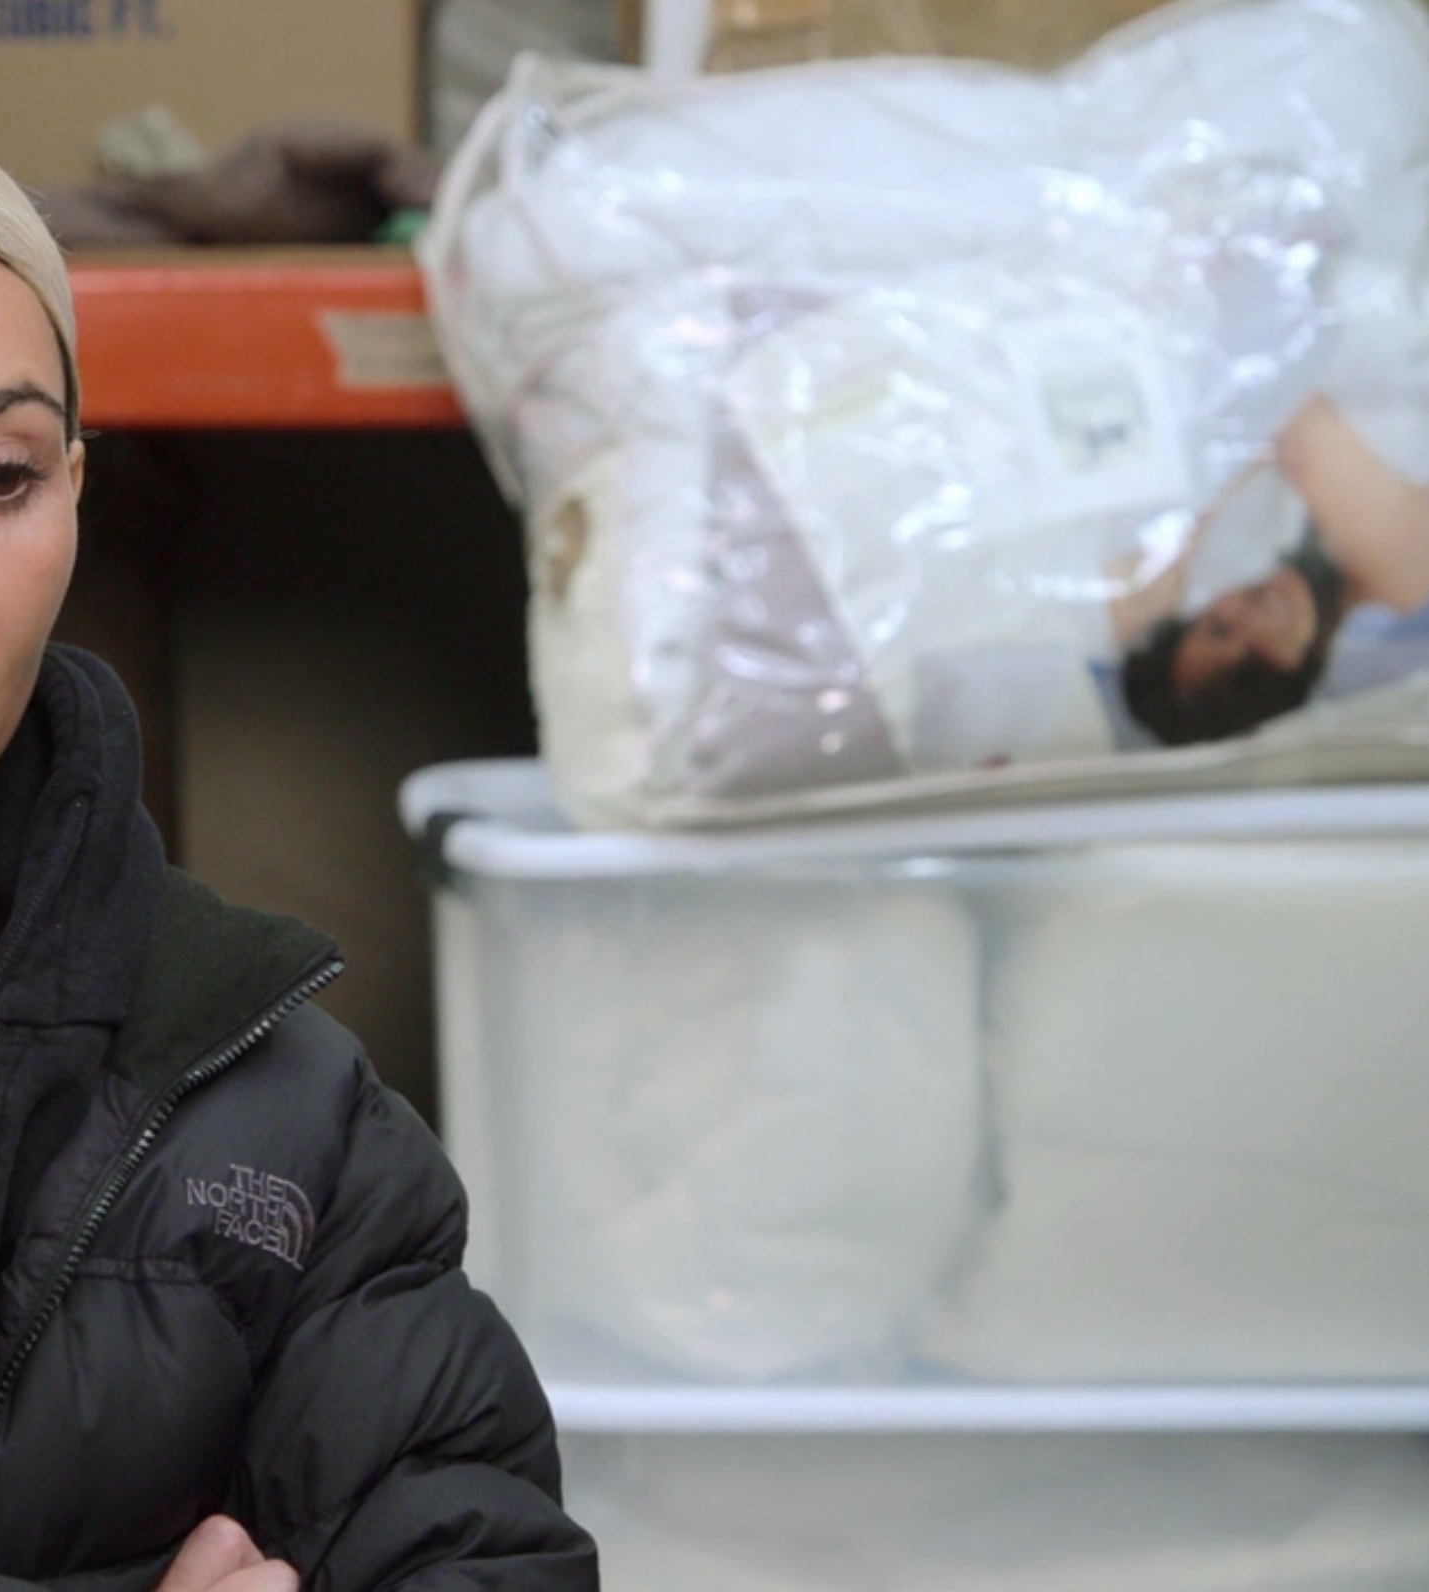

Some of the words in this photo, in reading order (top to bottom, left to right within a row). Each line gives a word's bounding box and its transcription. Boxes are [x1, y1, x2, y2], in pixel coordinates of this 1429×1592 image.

[185, 1178, 283, 1230] NORTH
[230, 1163, 286, 1202] THE
[214, 1208, 283, 1254] FACE
